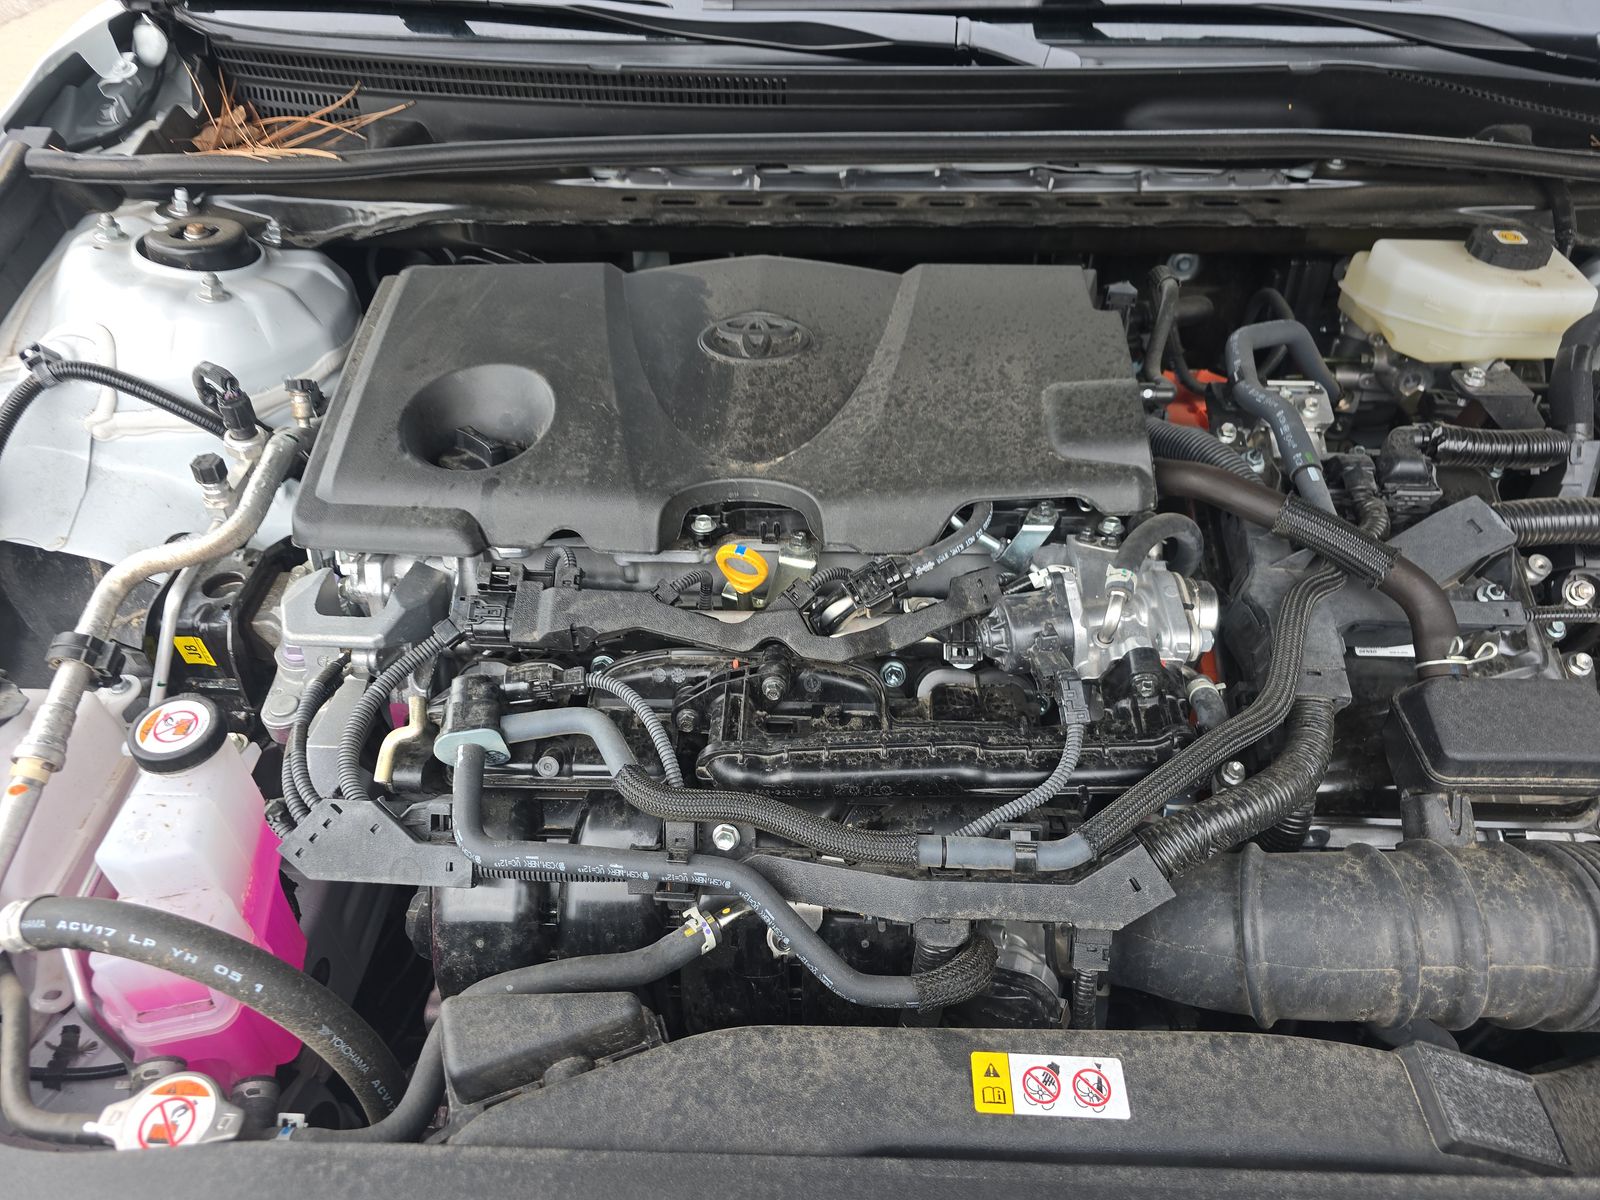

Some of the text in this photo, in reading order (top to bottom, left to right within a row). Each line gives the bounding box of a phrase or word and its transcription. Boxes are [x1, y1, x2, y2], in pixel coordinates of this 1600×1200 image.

[184, 645, 202, 658] J8
[56, 919, 117, 938] ACV17
[128, 933, 157, 949] LP
[170, 946, 199, 964] YH
[254, 982, 265, 993] 1
[329, 1032, 371, 1074] YOKOHAMA
